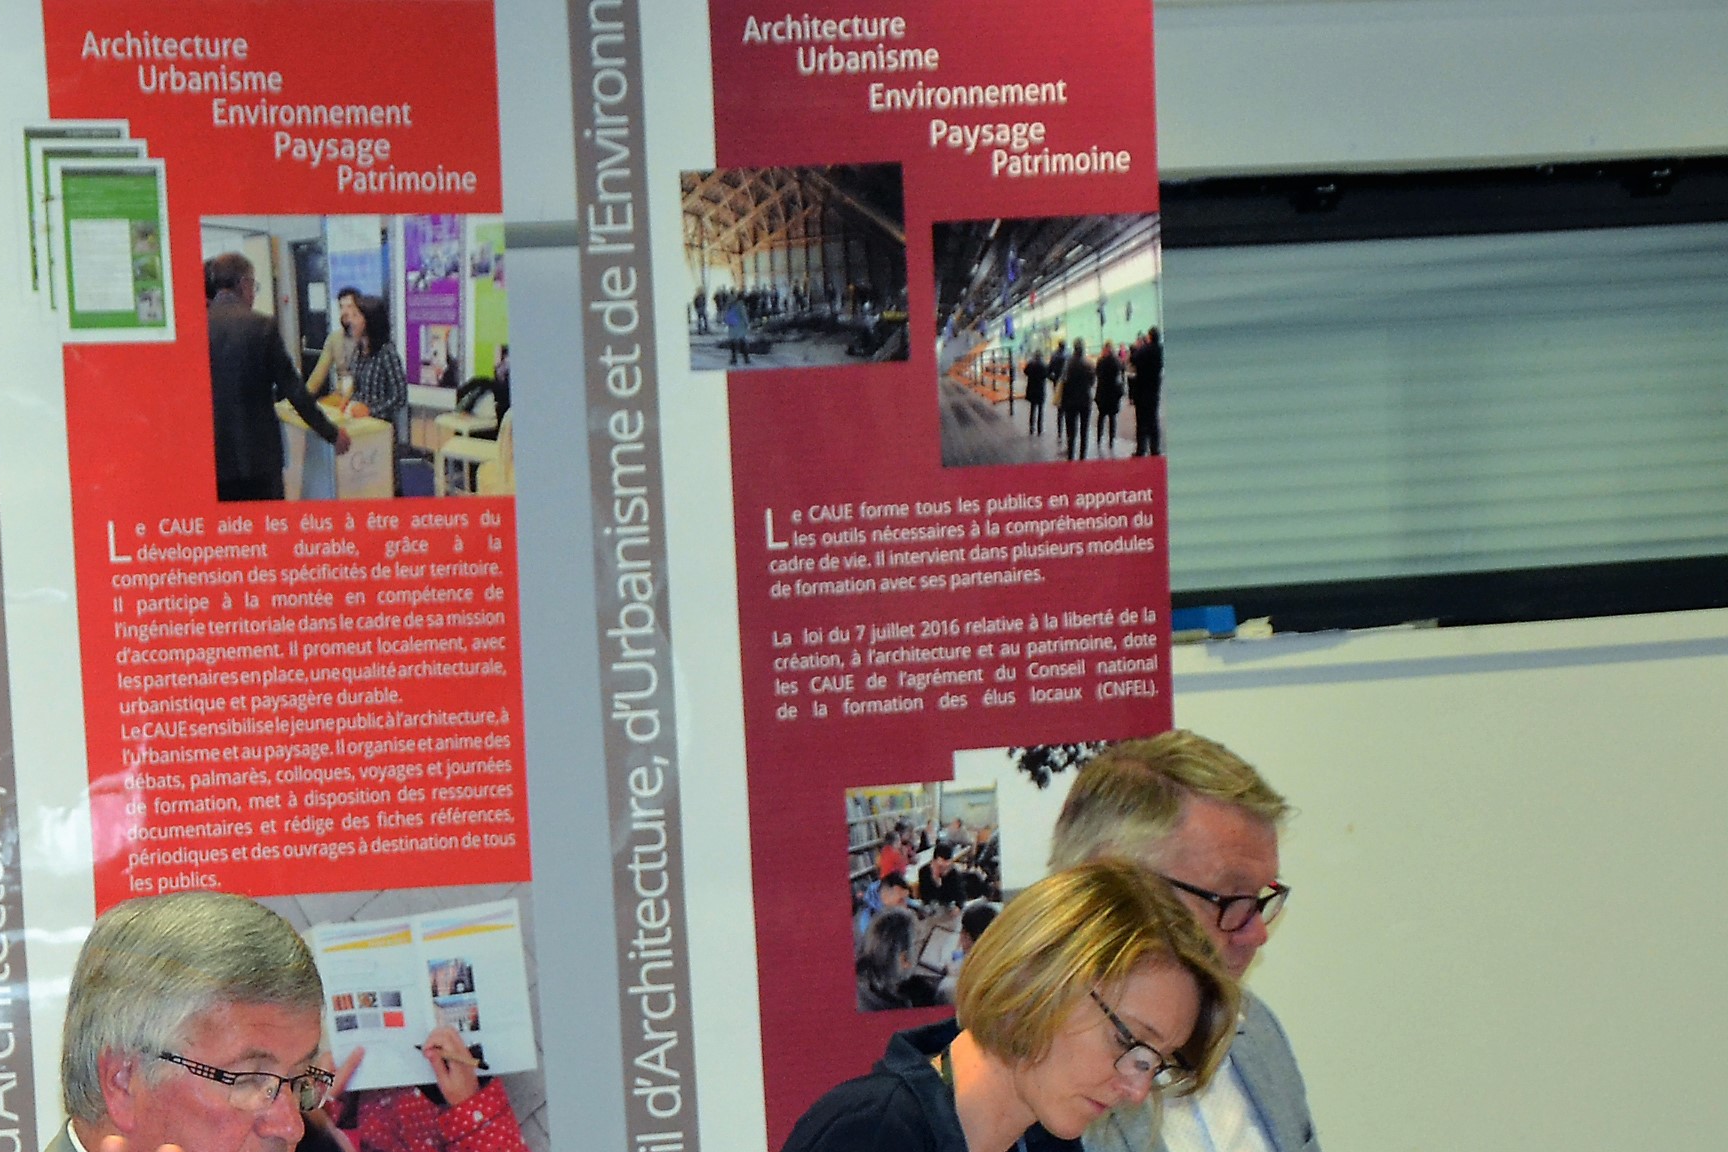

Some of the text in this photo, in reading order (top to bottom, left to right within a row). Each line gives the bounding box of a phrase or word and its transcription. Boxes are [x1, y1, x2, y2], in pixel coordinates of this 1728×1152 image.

[742, 15, 905, 44] Architecture
[81, 31, 248, 59] Architecture
[797, 46, 939, 74] Urbanisme
[138, 66, 282, 92] Urbanisme
[869, 79, 1066, 111] Environnement
[213, 98, 411, 126] Environnement
[274, 132, 390, 166] Paysage
[930, 118, 1045, 153] Paysage
[992, 148, 1130, 177] Patrimoine
[337, 165, 476, 192] Patrimoine
[590, 267, 639, 334] de
[600, 344, 642, 397] et
[137, 543, 267, 564] développement
[385, 536, 428, 559] grâce
[453, 535, 464, 553] à
[488, 535, 502, 552] la
[603, 410, 660, 743] d'Urbanisme
[775, 678, 798, 695] les
[809, 675, 854, 693] CAUE
[866, 672, 887, 690] de
[994, 664, 1016, 682] du
[1027, 659, 1085, 679] Conseil
[1096, 655, 1157, 674] national
[776, 703, 797, 720] de
[813, 701, 827, 717] la
[843, 696, 923, 715] formation
[938, 692, 967, 709] des
[982, 689, 1015, 706] élus
[1030, 686, 1082, 702] locaux
[127, 823, 252, 841] documentaires
[260, 819, 276, 834] et
[284, 815, 334, 836] rédige
[342, 813, 369, 830] des
[377, 811, 423, 828] fiches
